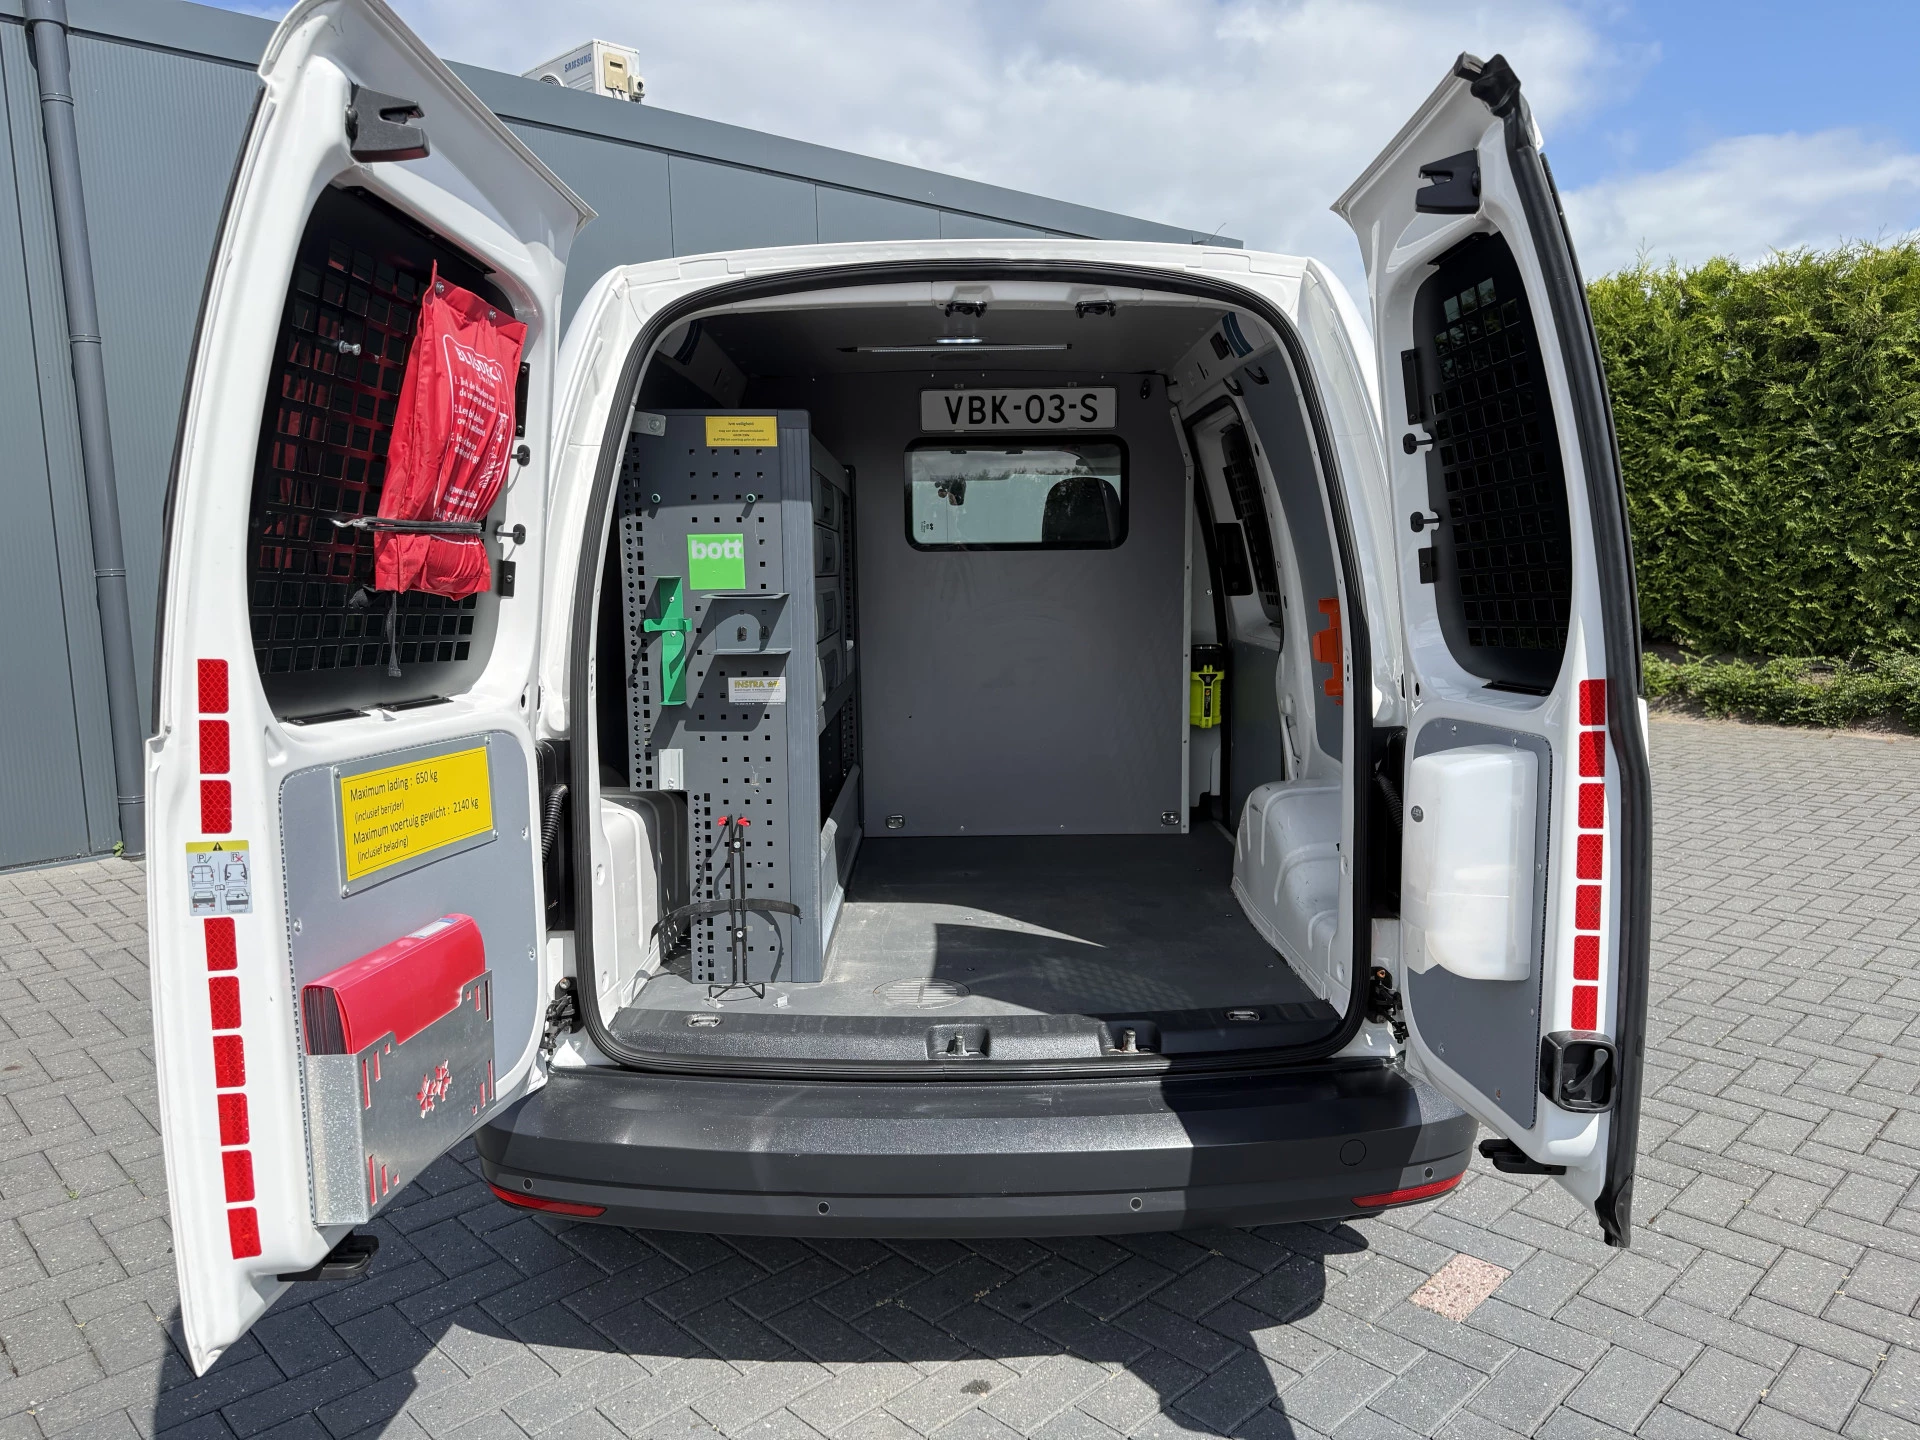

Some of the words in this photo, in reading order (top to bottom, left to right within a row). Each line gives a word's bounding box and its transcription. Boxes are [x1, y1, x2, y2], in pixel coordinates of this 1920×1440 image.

[564, 53, 592, 73] SAMSUNG
[944, 393, 1098, 425] VBK-03-S
[691, 539, 744, 560] bott
[734, 680, 765, 689] INSTRA
[350, 784, 386, 802] Maximum
[387, 777, 409, 792] lading
[415, 770, 429, 785] 650
[430, 769, 438, 783] kg
[353, 825, 389, 845] Maximum
[390, 815, 419, 832] voertuig
[420, 806, 446, 826] gewicht
[453, 798, 470, 814] 2140
[470, 797, 479, 809] kg
[355, 806, 380, 825] (inclusief
[380, 800, 405, 816] berijder)
[357, 846, 383, 865] (inclusief
[383, 836, 409, 853] belading)
